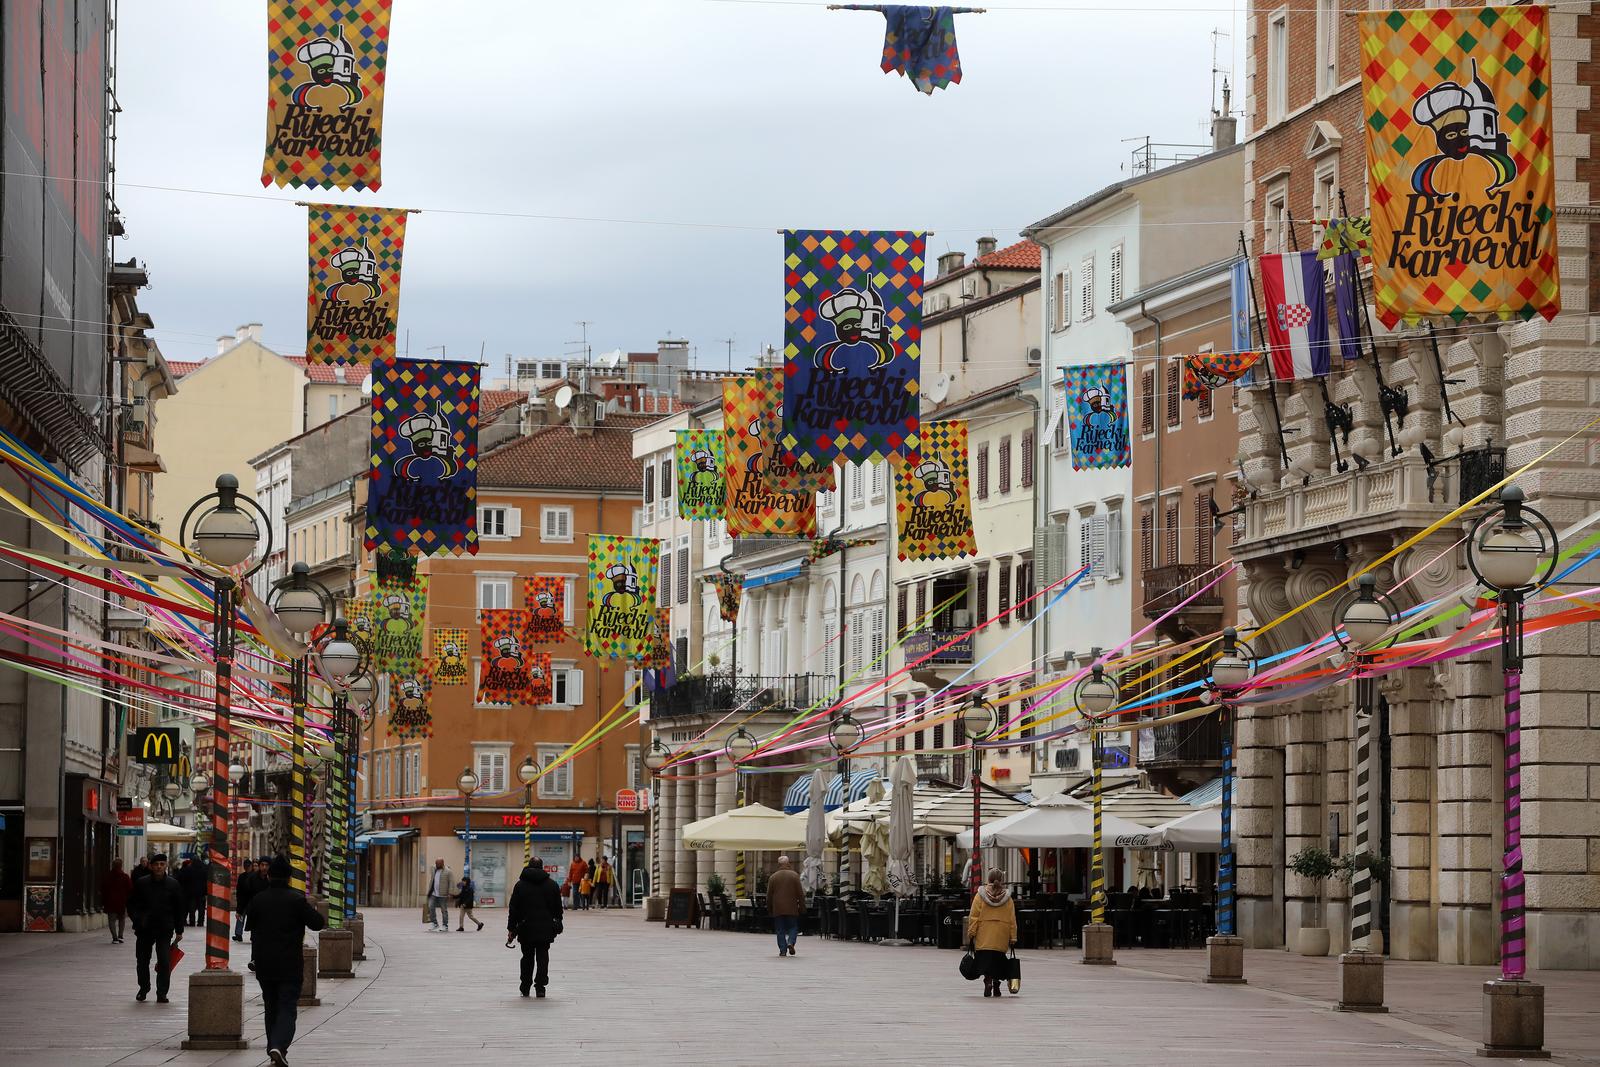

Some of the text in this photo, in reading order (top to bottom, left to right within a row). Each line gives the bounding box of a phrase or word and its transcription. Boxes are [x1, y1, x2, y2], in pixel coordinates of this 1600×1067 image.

[272, 124, 376, 157] karneval
[1399, 190, 1536, 248] Riječki
[1387, 221, 1543, 279] karneval
[310, 316, 392, 340] karneval
[791, 390, 912, 430] karneval
[1075, 434, 1126, 455] karneval
[682, 491, 726, 507] karneval
[733, 488, 811, 515] karneval
[903, 516, 969, 541] karneval
[590, 618, 650, 640] karneval
